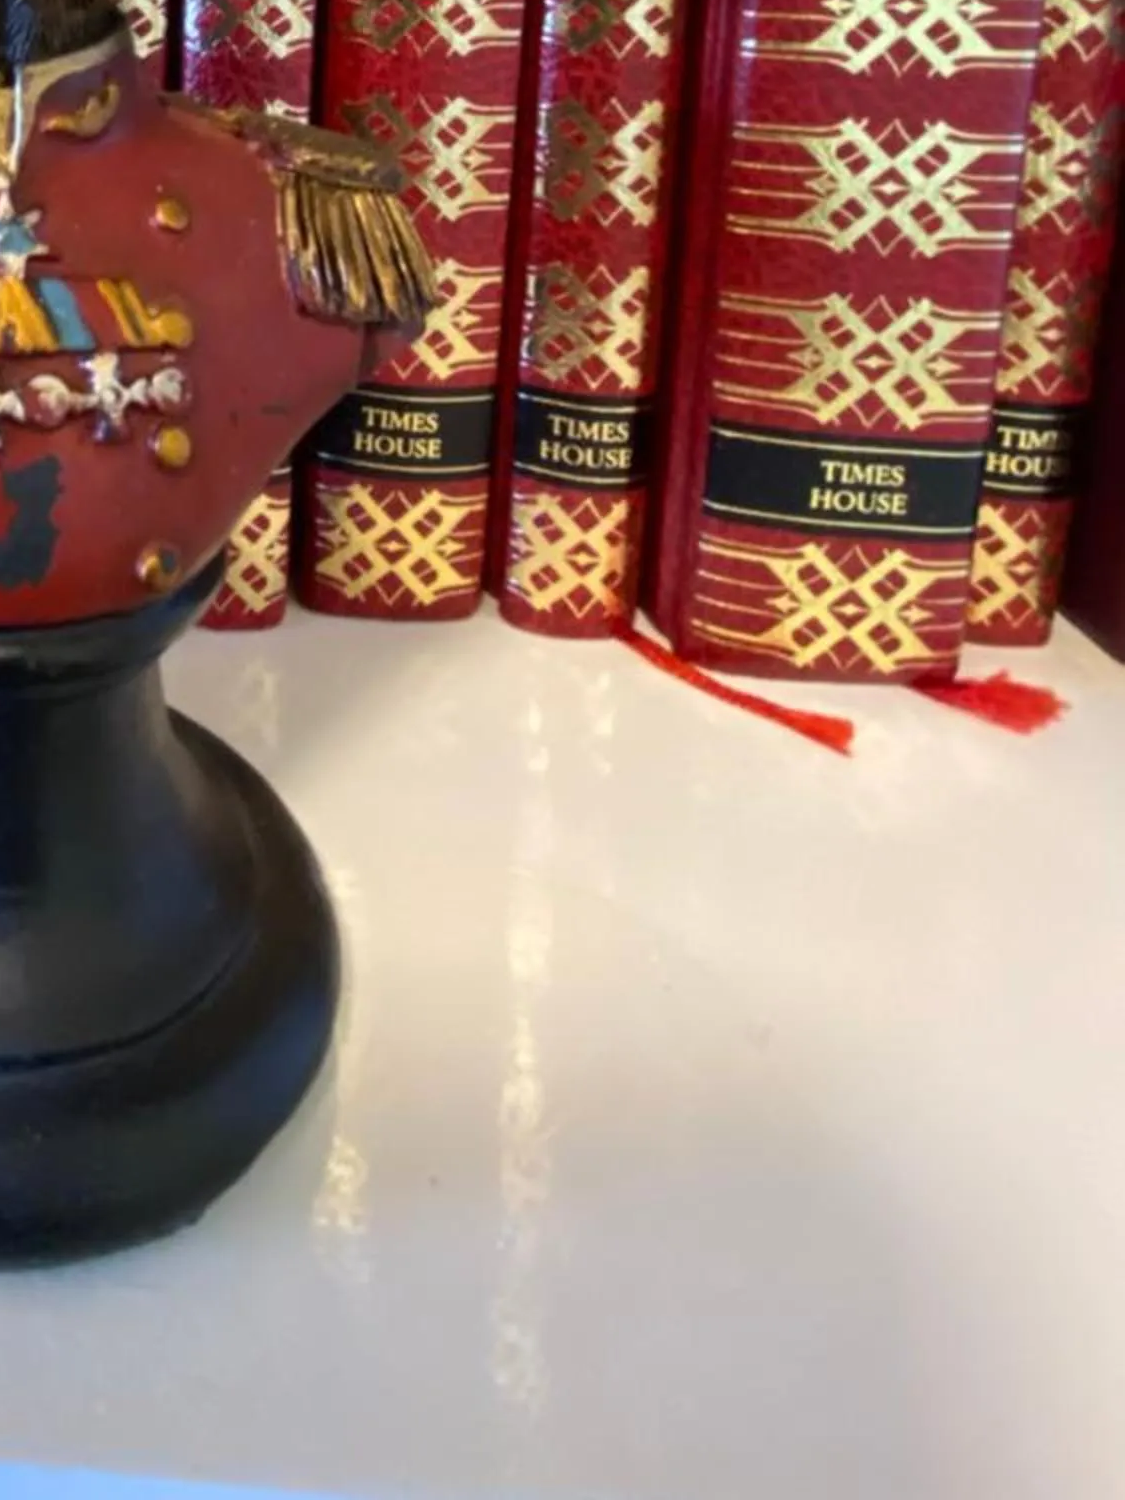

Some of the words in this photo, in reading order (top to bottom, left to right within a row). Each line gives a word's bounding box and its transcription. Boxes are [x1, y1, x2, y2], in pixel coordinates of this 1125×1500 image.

[361, 407, 440, 434] TIMES
[547, 414, 630, 443] TIMES
[353, 431, 443, 460] HOUSE
[539, 440, 632, 470] HOUSE
[820, 459, 906, 488] TIMES
[808, 488, 908, 516] HOUSE
